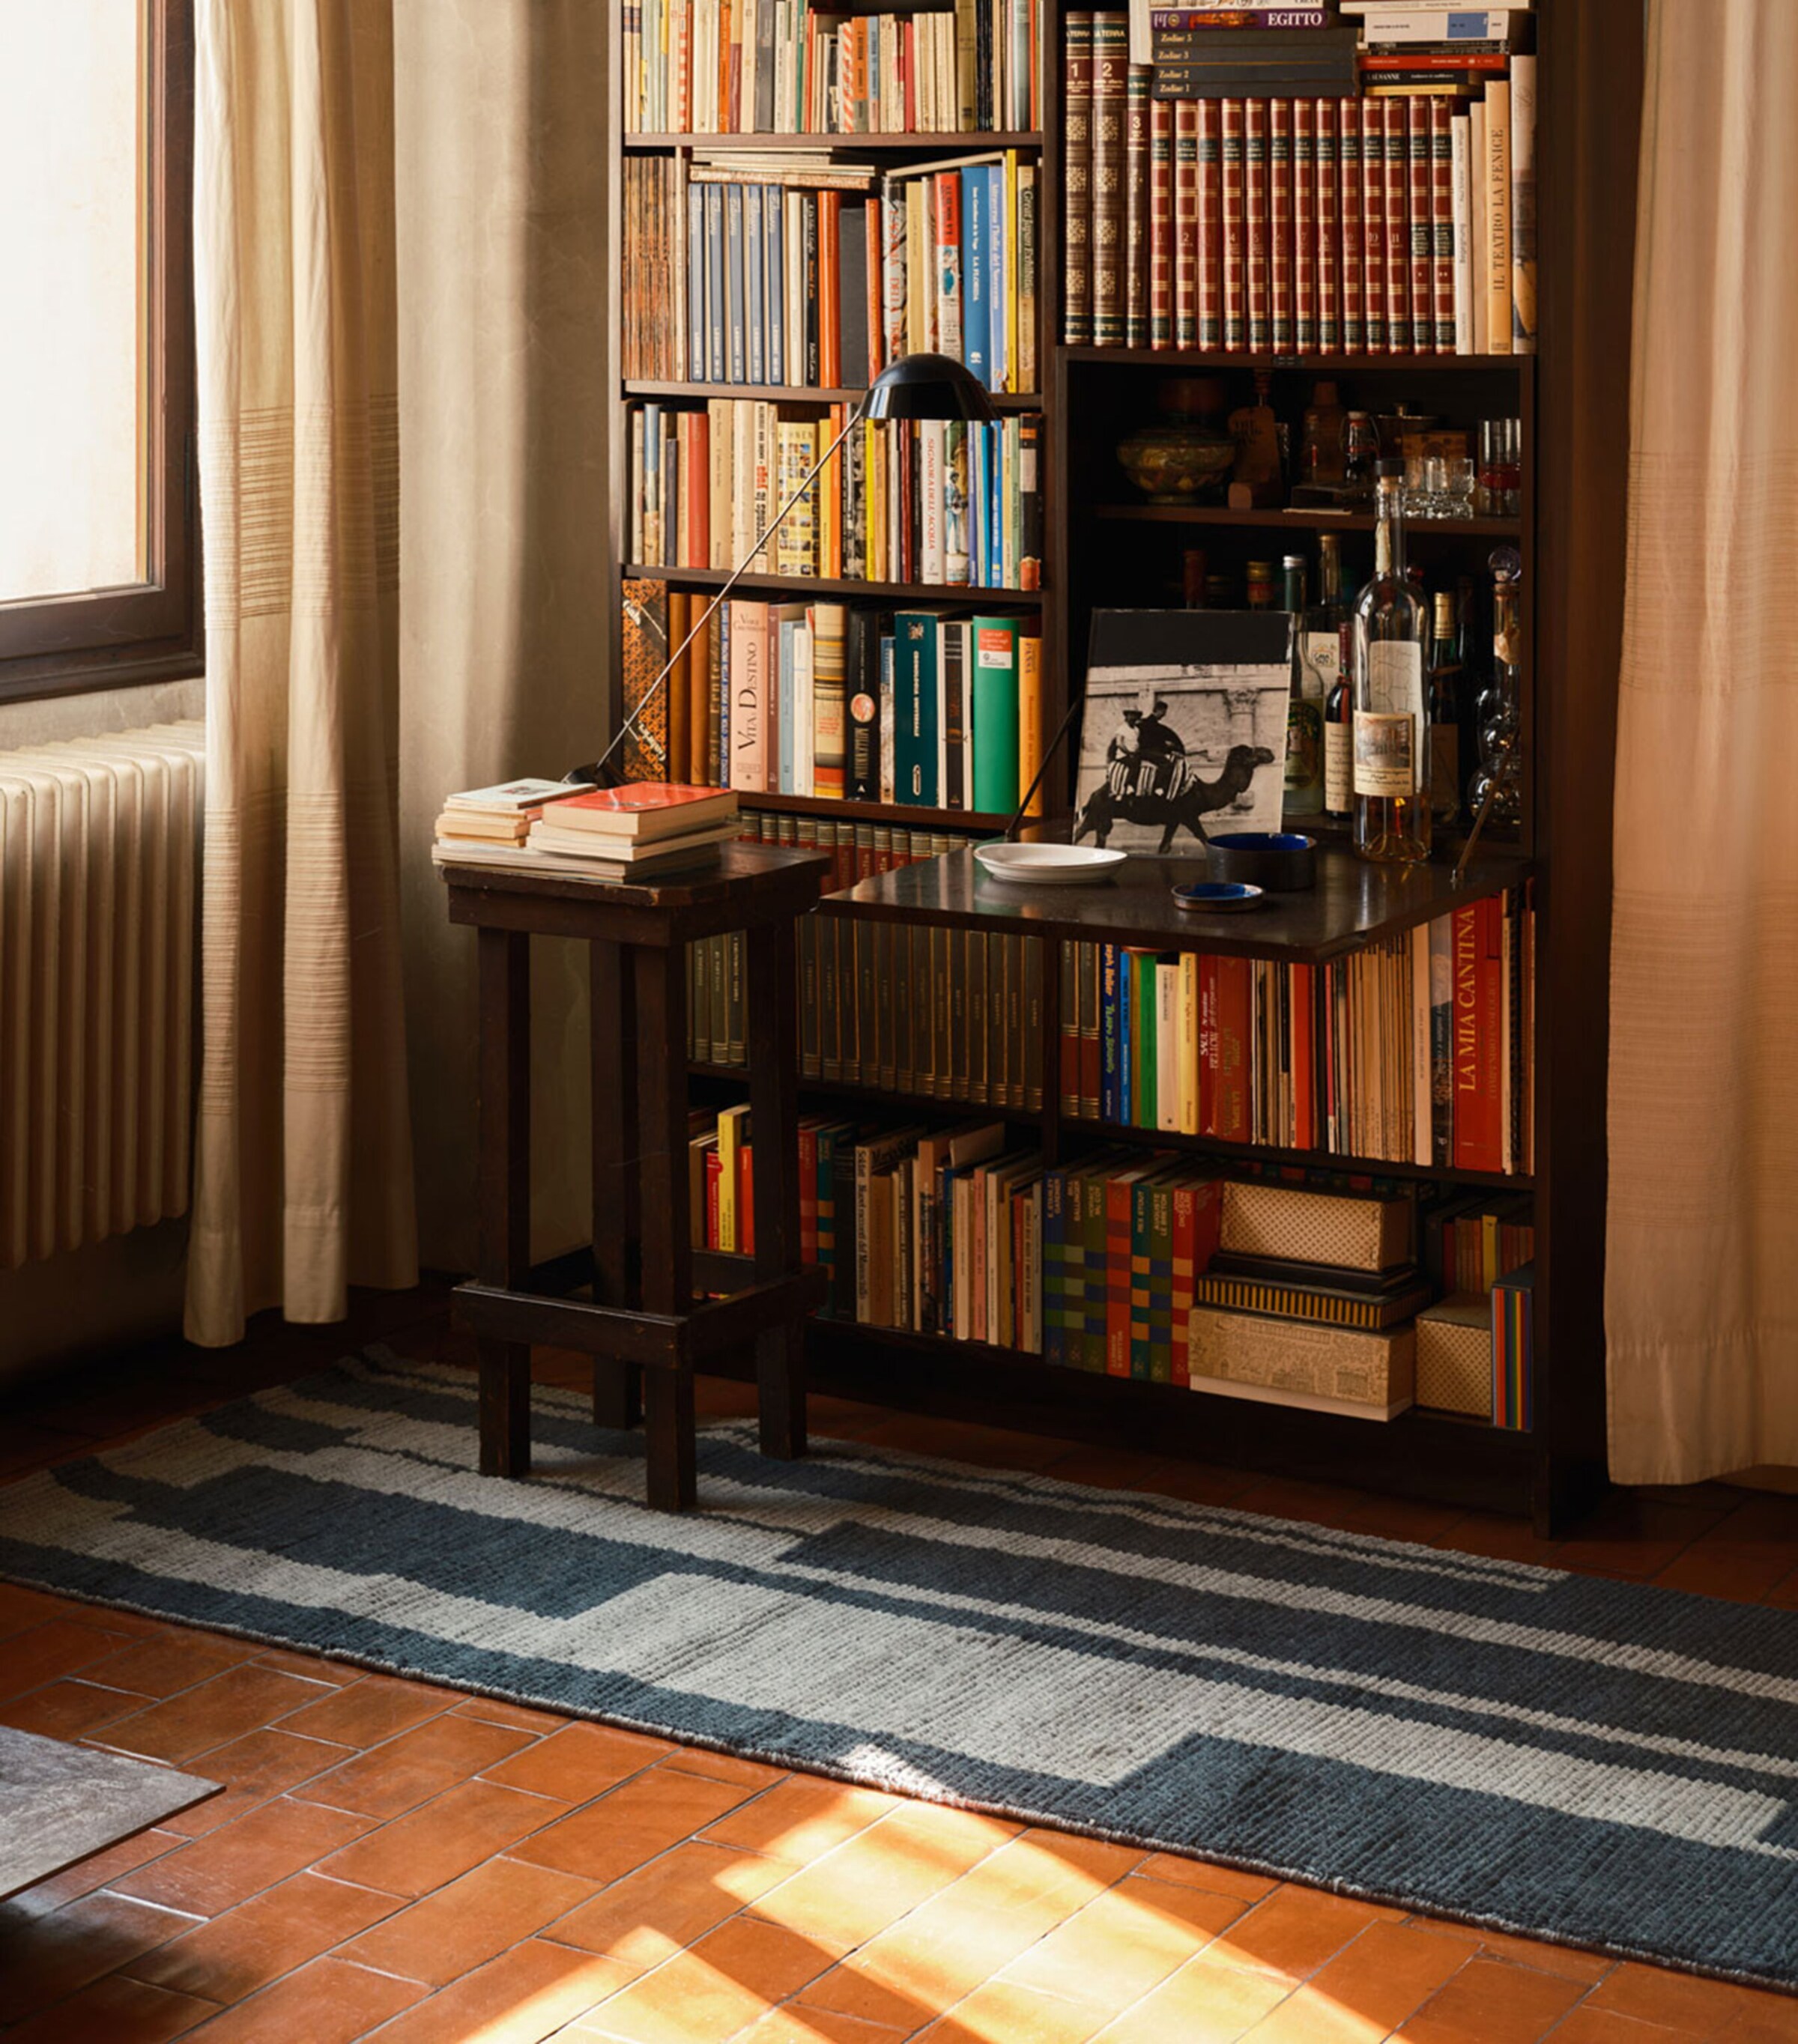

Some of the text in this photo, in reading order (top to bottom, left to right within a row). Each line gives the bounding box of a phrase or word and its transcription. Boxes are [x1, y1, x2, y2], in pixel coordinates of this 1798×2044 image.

[1268, 10, 1322, 26] EGITTO
[1160, 32, 1185, 43] Zodiac
[1157, 50, 1181, 60] Zodiac
[1071, 63, 1079, 77] 1
[1102, 62, 1113, 77] 2
[1158, 70, 1182, 79] Zodiac
[1160, 83, 1184, 93] Zodiac
[1132, 116, 1141, 129] 3
[1491, 129, 1506, 291] IL TEATRO LA FENICE
[1183, 233, 1190, 242] 2
[1229, 232, 1235, 243] 4
[1368, 232, 1378, 242] 10
[1021, 190, 1035, 299] Great Japan Exhibition
[972, 256, 979, 267] LA
[927, 438, 936, 485] SIGNORA
[756, 466, 768, 488] yoga
[755, 491, 766, 501] le
[1458, 909, 1476, 1091] LA MIA CANTINA
[1199, 1031, 1208, 1056] SAUL
[1208, 1031, 1219, 1069] BELLOW
[1160, 1226, 1168, 1237] LE
[858, 1240, 868, 1253] del
